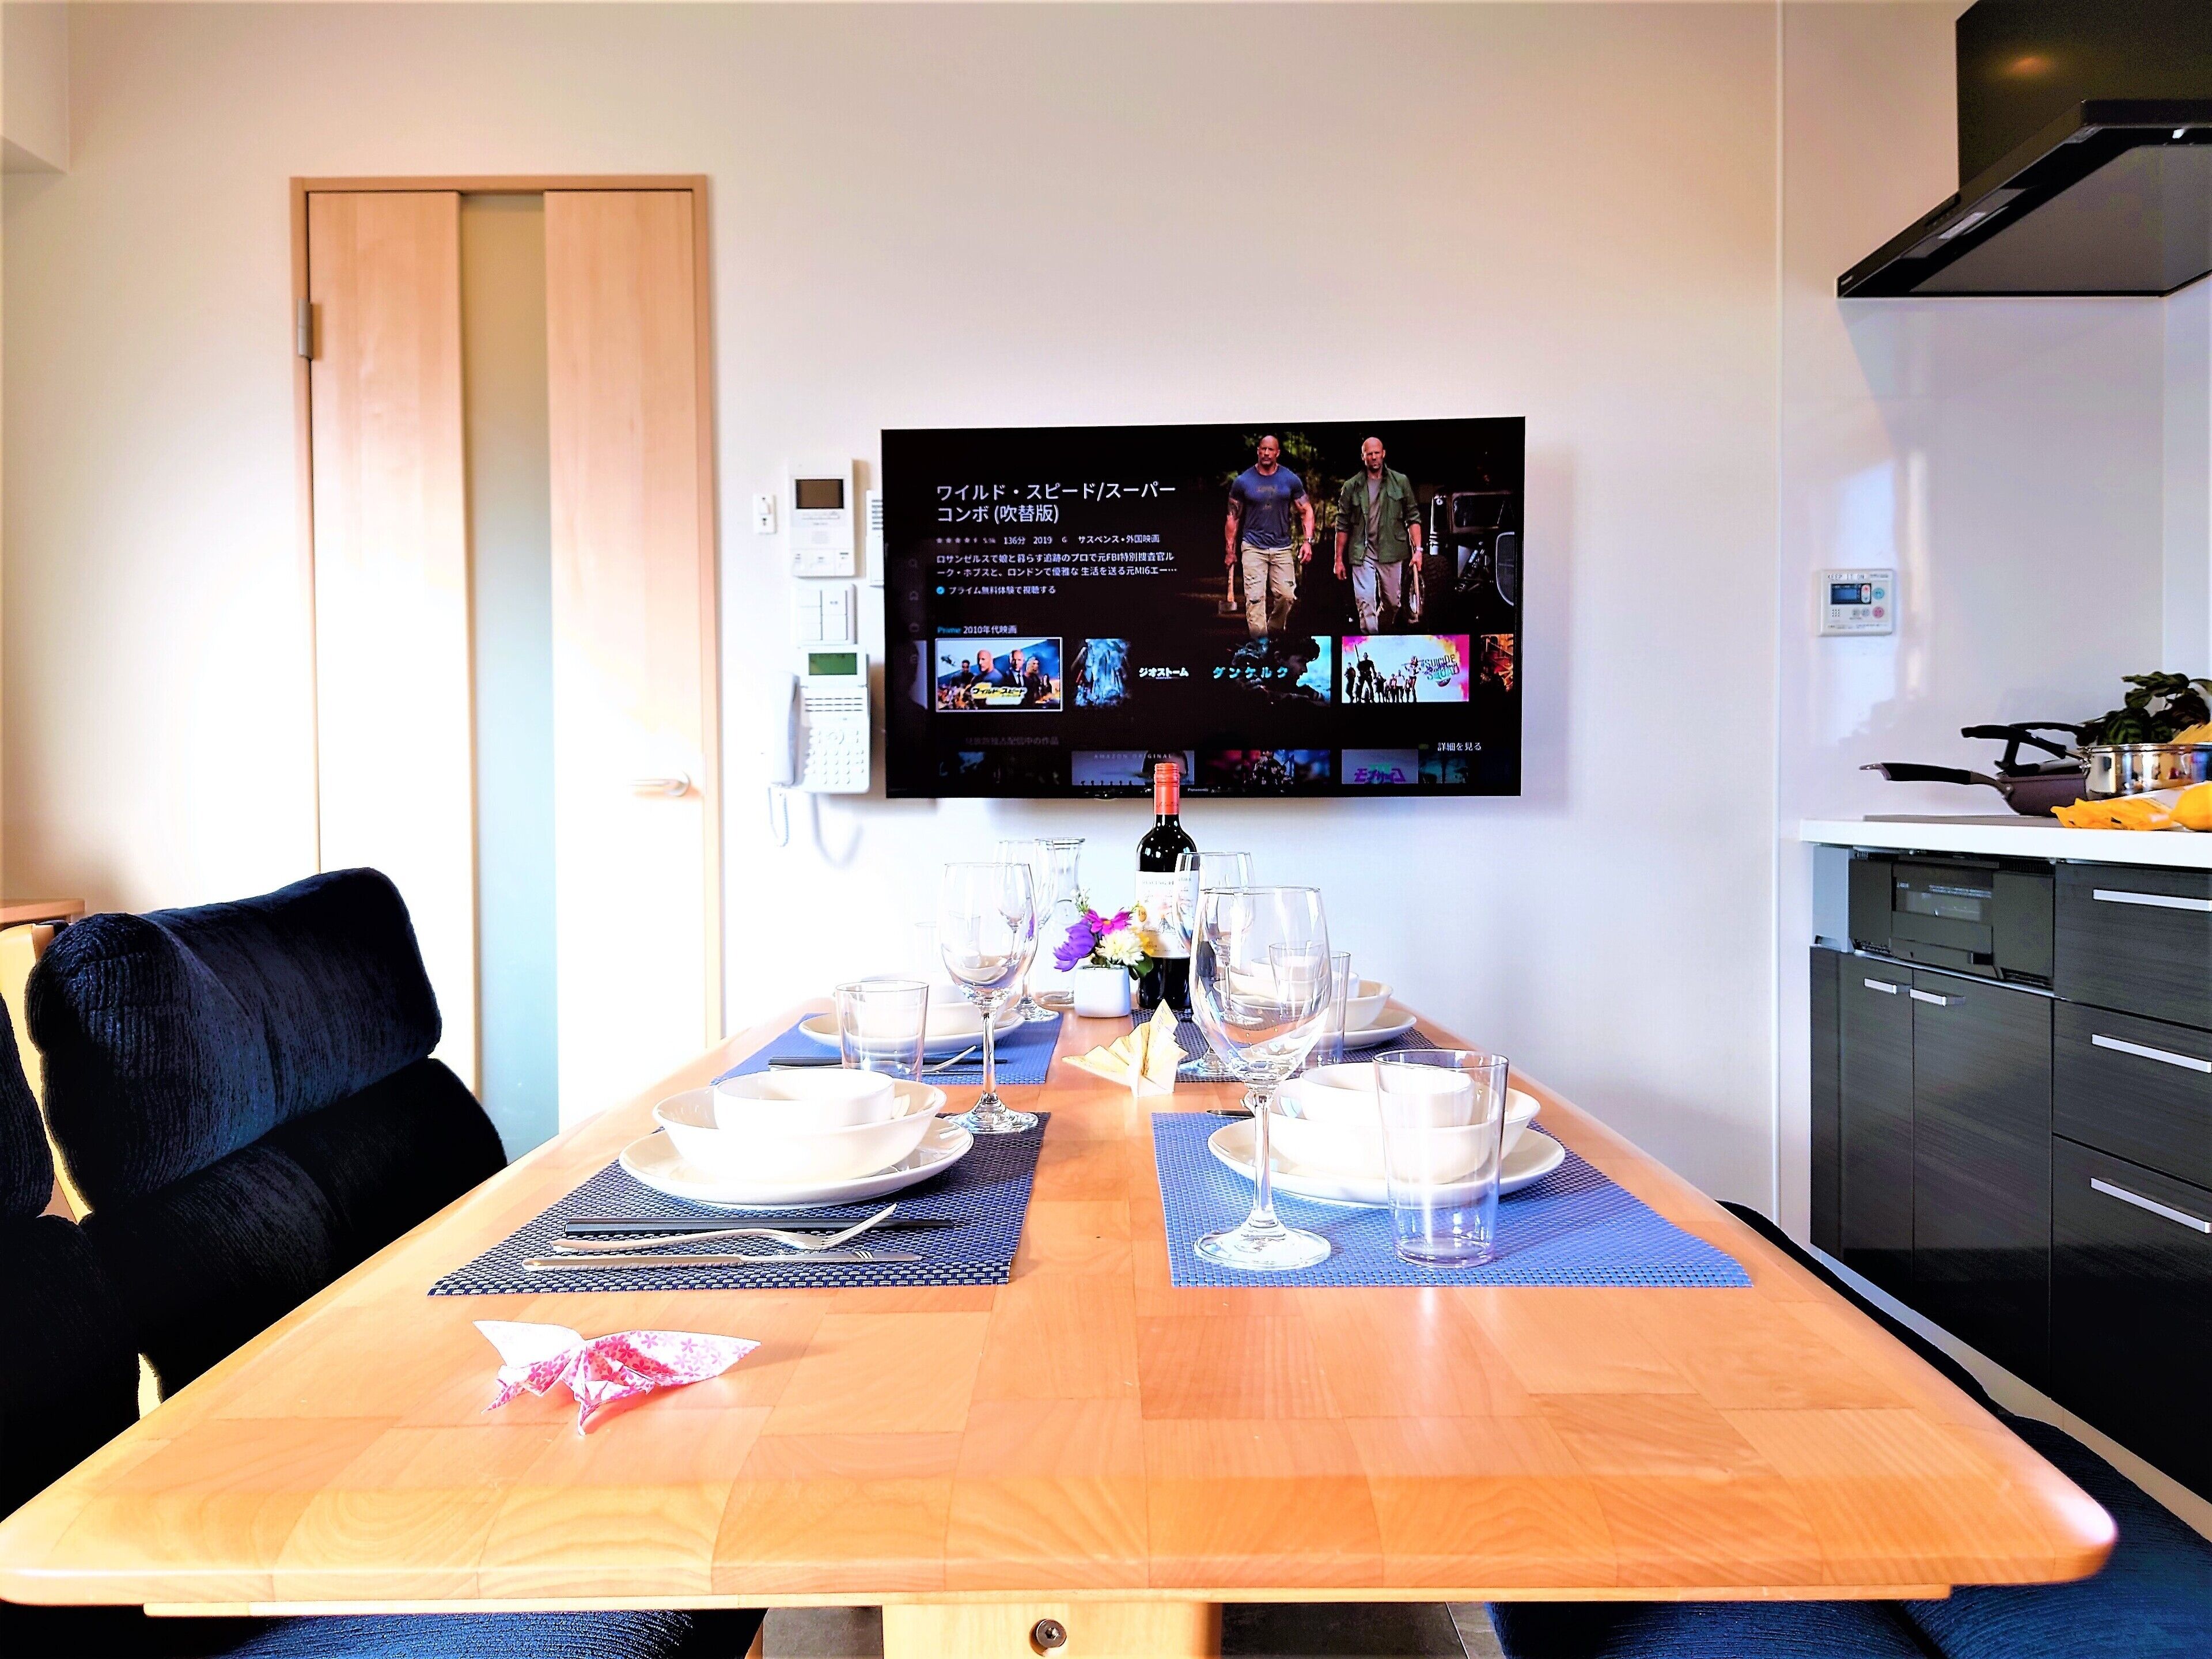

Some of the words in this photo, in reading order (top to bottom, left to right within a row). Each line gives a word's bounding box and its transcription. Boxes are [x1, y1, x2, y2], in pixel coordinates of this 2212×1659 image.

[937, 480, 1176, 502] ワイルド・スピード/スーパー
[938, 505, 990, 522] コンボ
[994, 504, 1059, 524] (吹替版)
[1003, 536, 1026, 545] 136分
[1033, 536, 1053, 544] 2019
[1078, 534, 1161, 544] サスペンス・外国映画
[963, 624, 1018, 634] 2010年代映画
[1139, 666, 1189, 677] ジオストーム
[1213, 666, 1288, 679] ダンケルク
[1437, 742, 1482, 751] 詳細を見る
